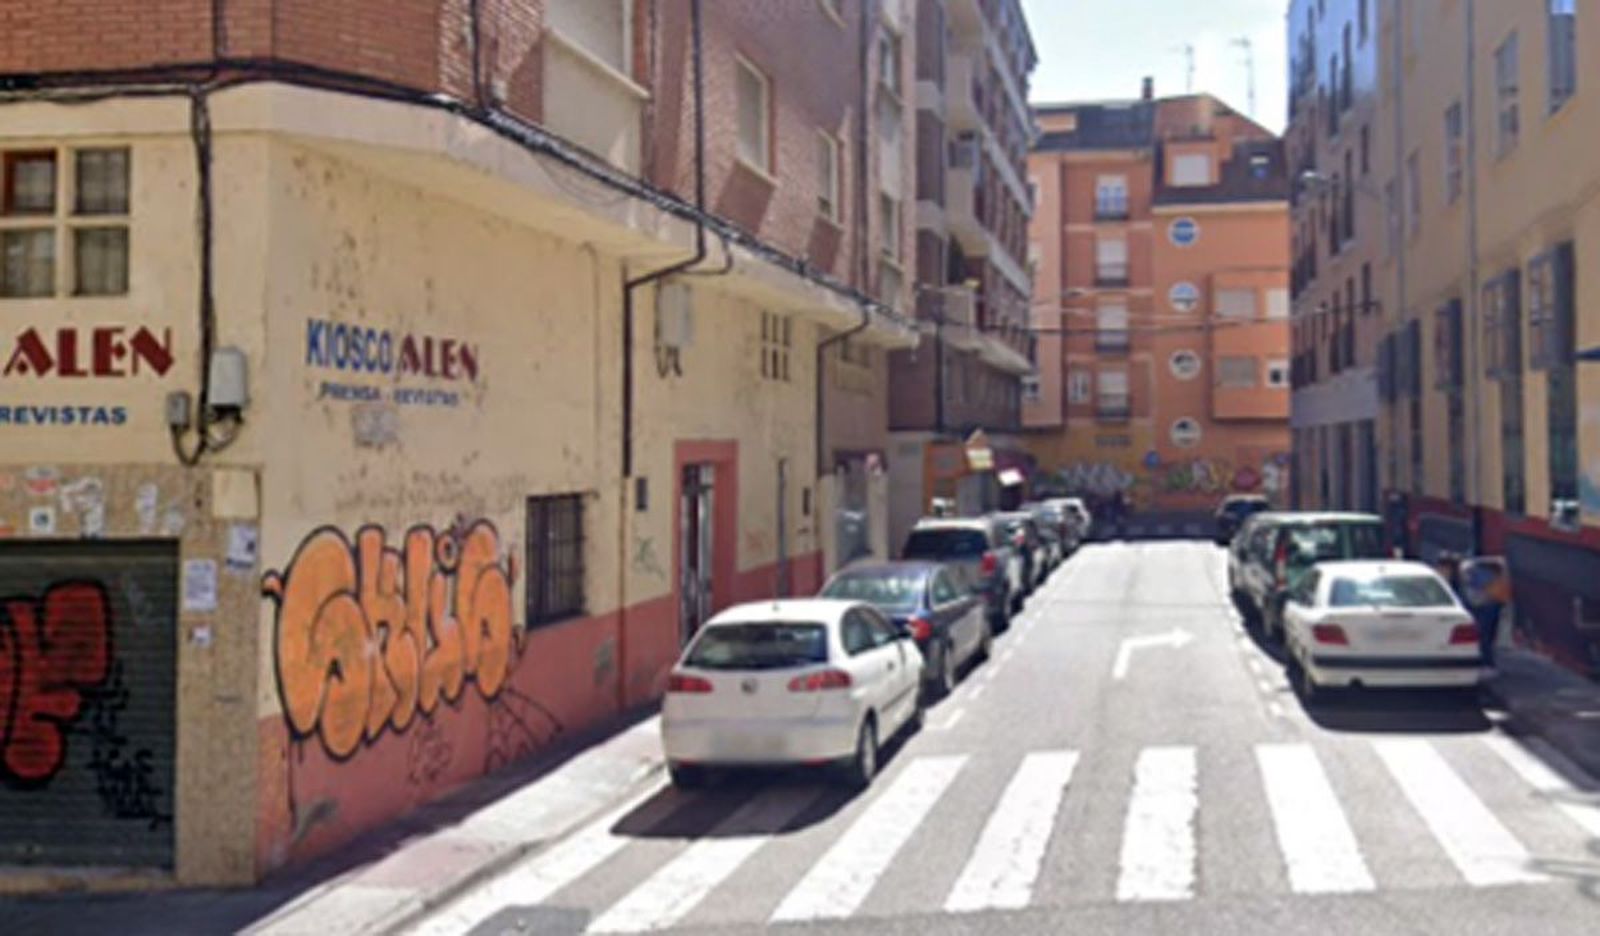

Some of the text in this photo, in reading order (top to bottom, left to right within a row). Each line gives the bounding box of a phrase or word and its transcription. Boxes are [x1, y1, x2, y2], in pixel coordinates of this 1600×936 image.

[3, 325, 174, 378] ALEN
[306, 317, 478, 382] KIOSCO ALEN
[0, 406, 127, 425] REVISTAS
